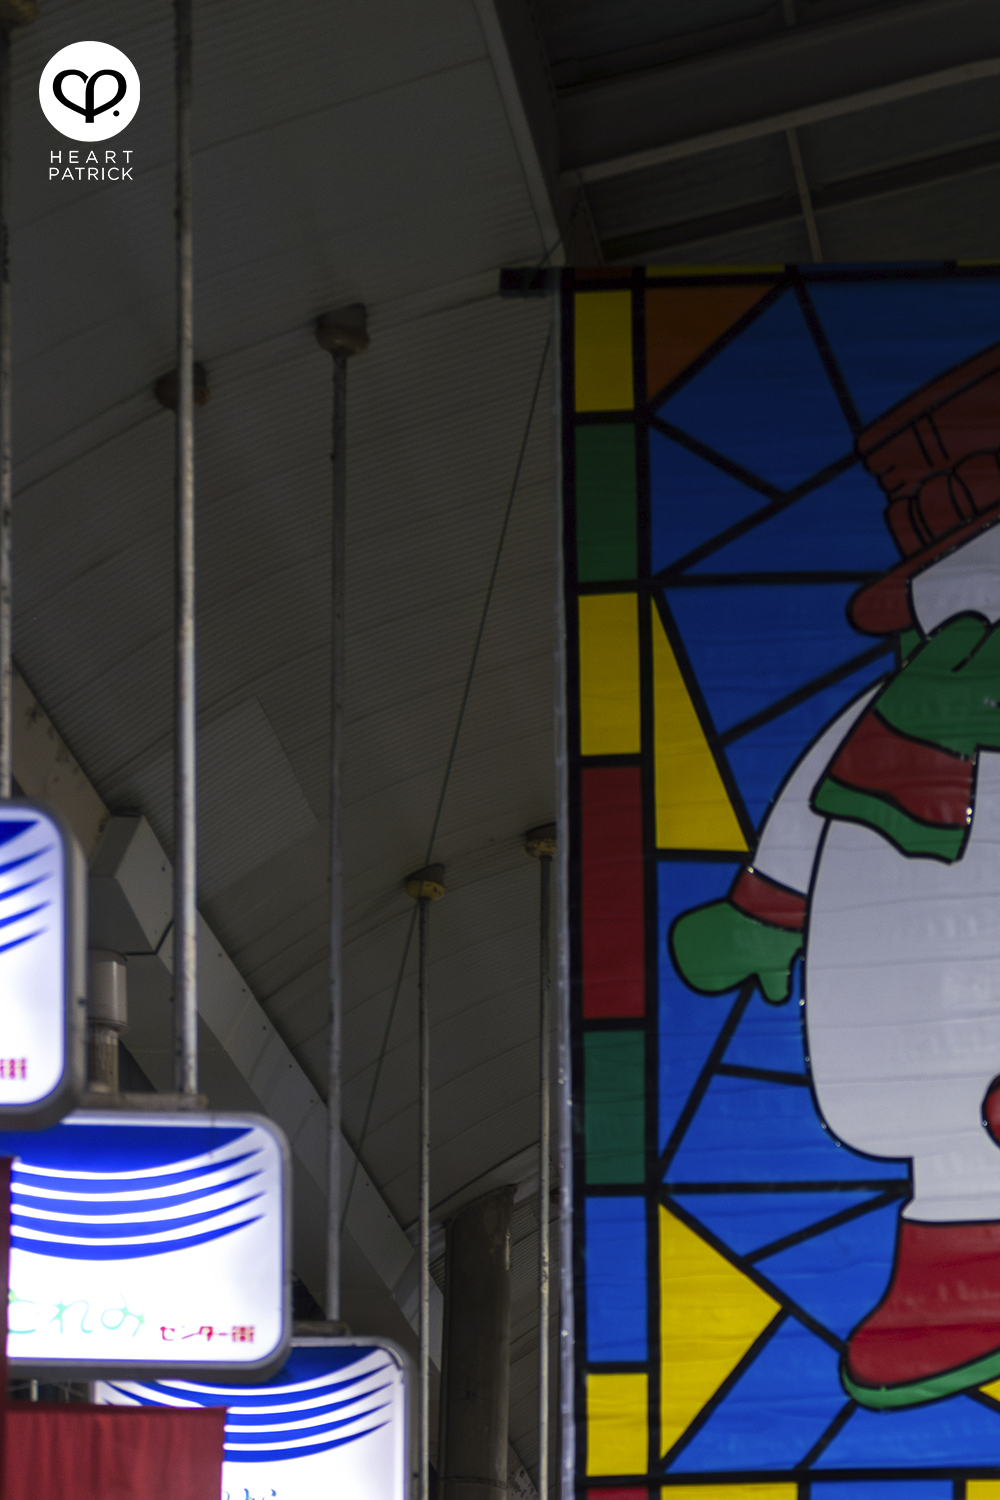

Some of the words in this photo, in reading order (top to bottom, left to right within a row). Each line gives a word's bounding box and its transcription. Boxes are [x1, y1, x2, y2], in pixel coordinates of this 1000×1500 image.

[160, 1325, 255, 1343] センター街
